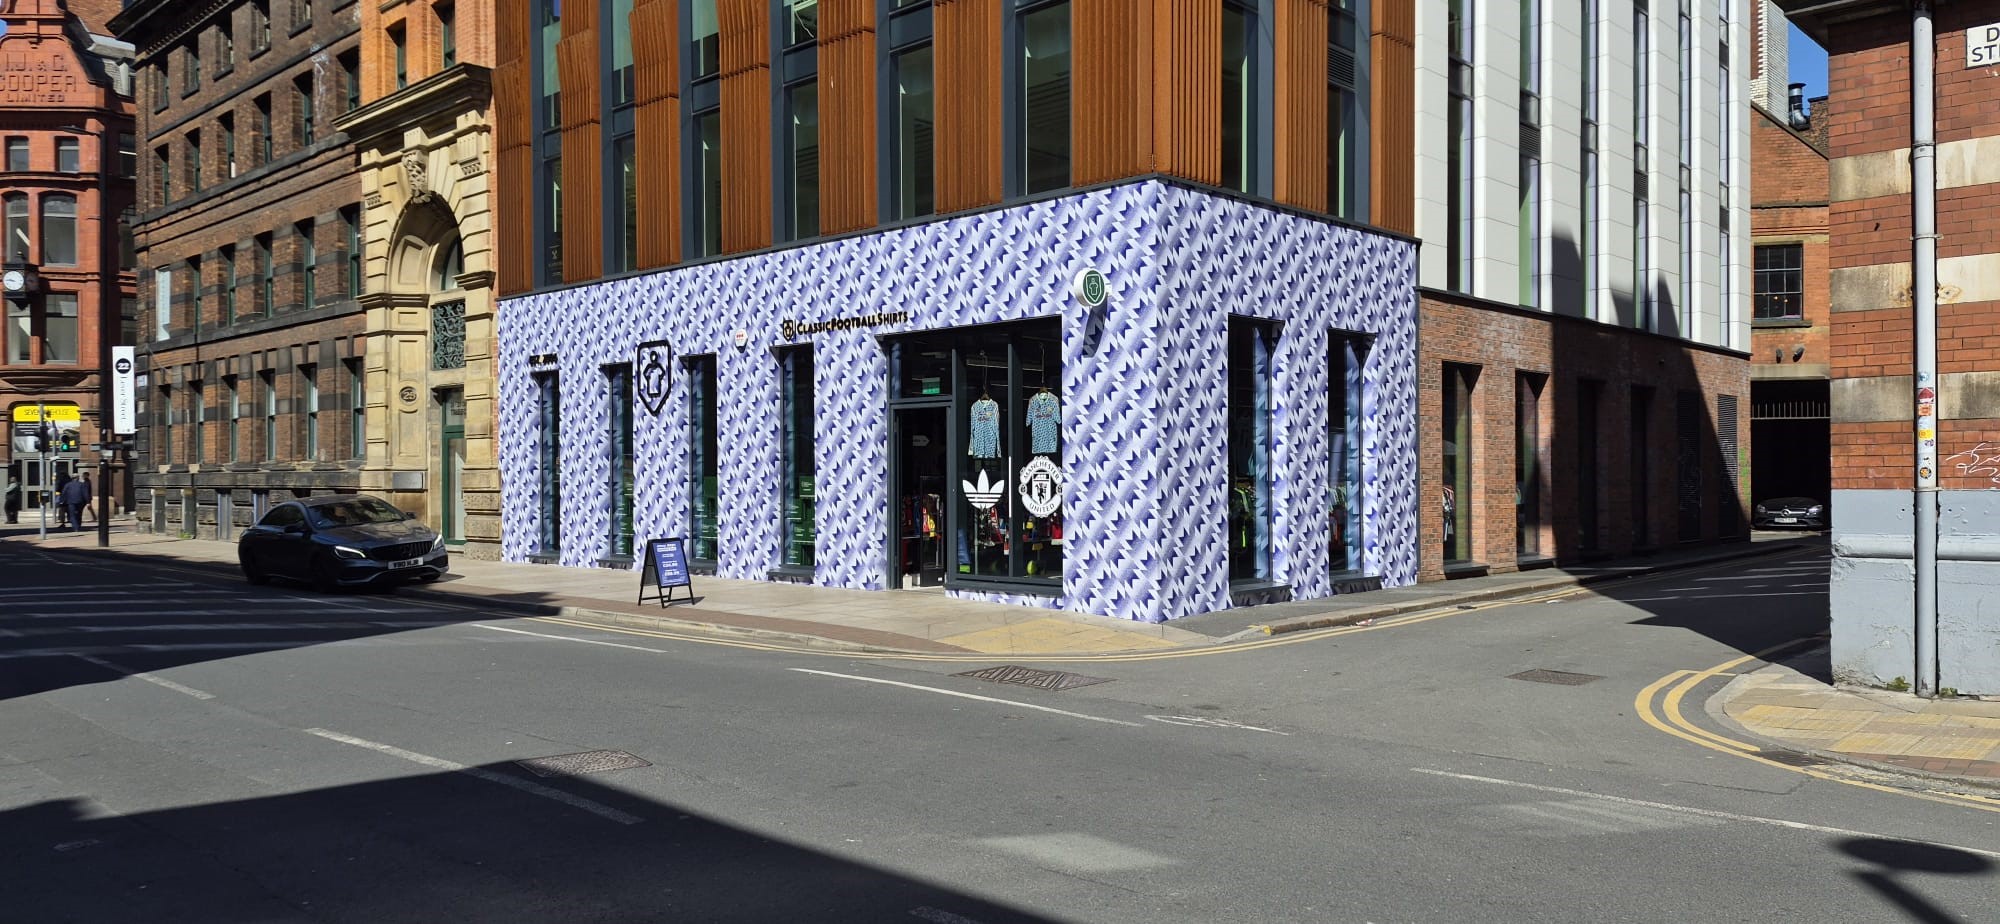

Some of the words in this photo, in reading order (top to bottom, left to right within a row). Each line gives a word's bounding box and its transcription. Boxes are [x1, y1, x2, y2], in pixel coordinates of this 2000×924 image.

[1971, 44, 2000, 62] ST
[7, 94, 66, 103] LIMITED
[117, 362, 130, 370] 22
[1023, 461, 1060, 480] MANCHESTER
[1030, 502, 1055, 513] UNITED
